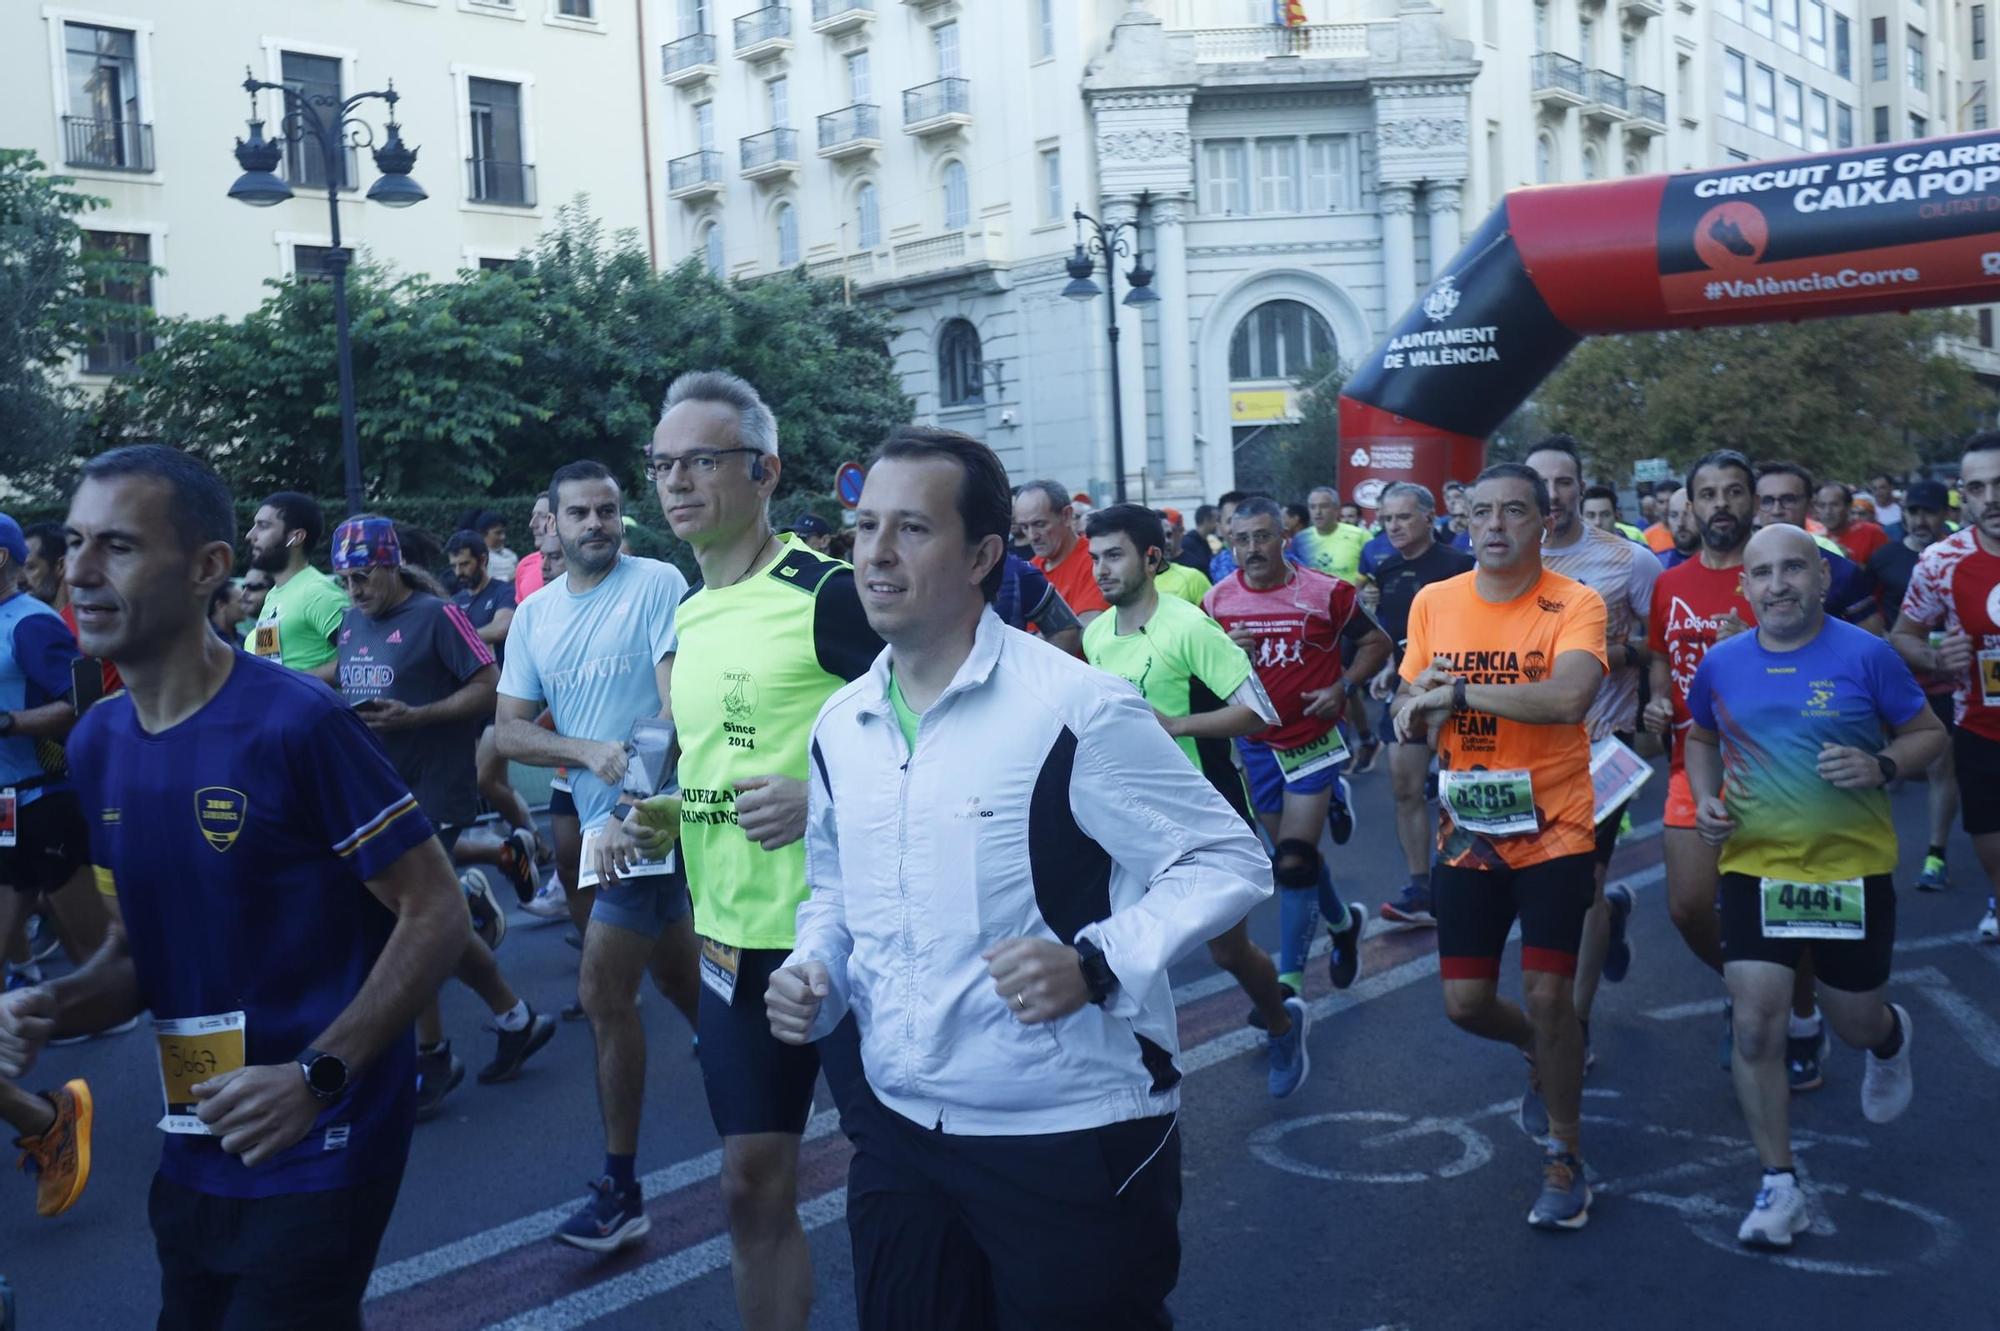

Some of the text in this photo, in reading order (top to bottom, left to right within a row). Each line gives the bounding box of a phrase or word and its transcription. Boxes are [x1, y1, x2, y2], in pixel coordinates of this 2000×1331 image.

[1694, 164, 1832, 198] CIRCUIT
[1837, 157, 1889, 182] DE
[1919, 197, 1981, 219] CIUTAT
[1704, 266, 1920, 300] #ValènciaCorre
[1387, 326, 1499, 352] AJUNTAMENT
[1383, 345, 1501, 369] DE VALÈNCIA
[723, 721, 757, 735] Since
[728, 736, 756, 750] 2014
[1457, 783, 1517, 810] 4385
[1779, 883, 1842, 912] 4441
